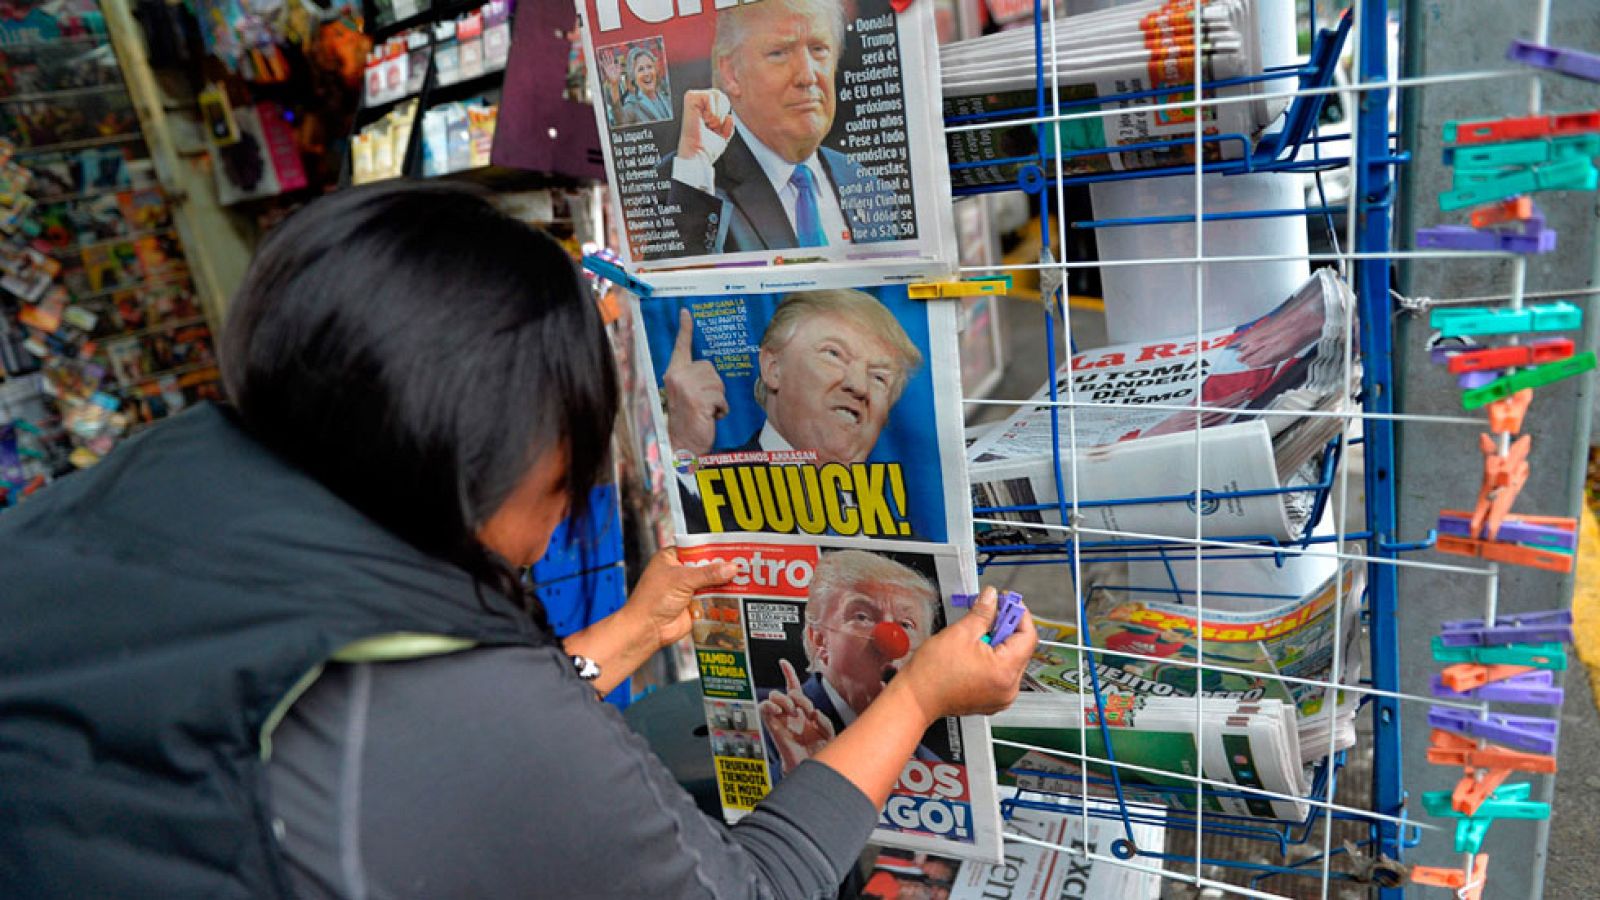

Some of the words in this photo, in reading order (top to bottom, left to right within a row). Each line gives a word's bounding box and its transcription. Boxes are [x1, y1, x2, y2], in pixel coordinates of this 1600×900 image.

[856, 13, 894, 32] Donald
[861, 33, 895, 48] Trump
[862, 49, 885, 65] será
[886, 46, 898, 61] el
[844, 64, 899, 84] Presidente
[840, 87, 852, 101] de
[853, 84, 868, 98] EU
[870, 84, 883, 97] en
[884, 81, 901, 95] los
[855, 98, 902, 117] próximos
[845, 117, 878, 132] cuatro
[880, 114, 904, 128] años
[848, 134, 871, 147] Pese
[873, 134, 880, 144] a
[882, 129, 905, 143] todo
[847, 147, 897, 165] pronóstico
[899, 146, 907, 161] y
[839, 184, 863, 197] ganó
[865, 180, 874, 192] al
[877, 177, 900, 191] final
[902, 178, 911, 189] a
[875, 193, 911, 208] Clinton
[873, 210, 898, 222] dólar
[900, 208, 913, 220] se
[870, 228, 878, 237] a
[1106, 358, 1211, 382] TOMA
[1079, 371, 1209, 394] BANDERA
[1092, 388, 1143, 401] DEL
[696, 462, 911, 536] FUUUCK!
[699, 652, 736, 665] TAMBO
[710, 665, 746, 678] TUMBA
[720, 759, 763, 773] TRUENAN
[721, 771, 766, 785] TIENDOTA
[893, 759, 964, 798] OS
[724, 783, 734, 792] DE
[737, 784, 763, 796] MOTA
